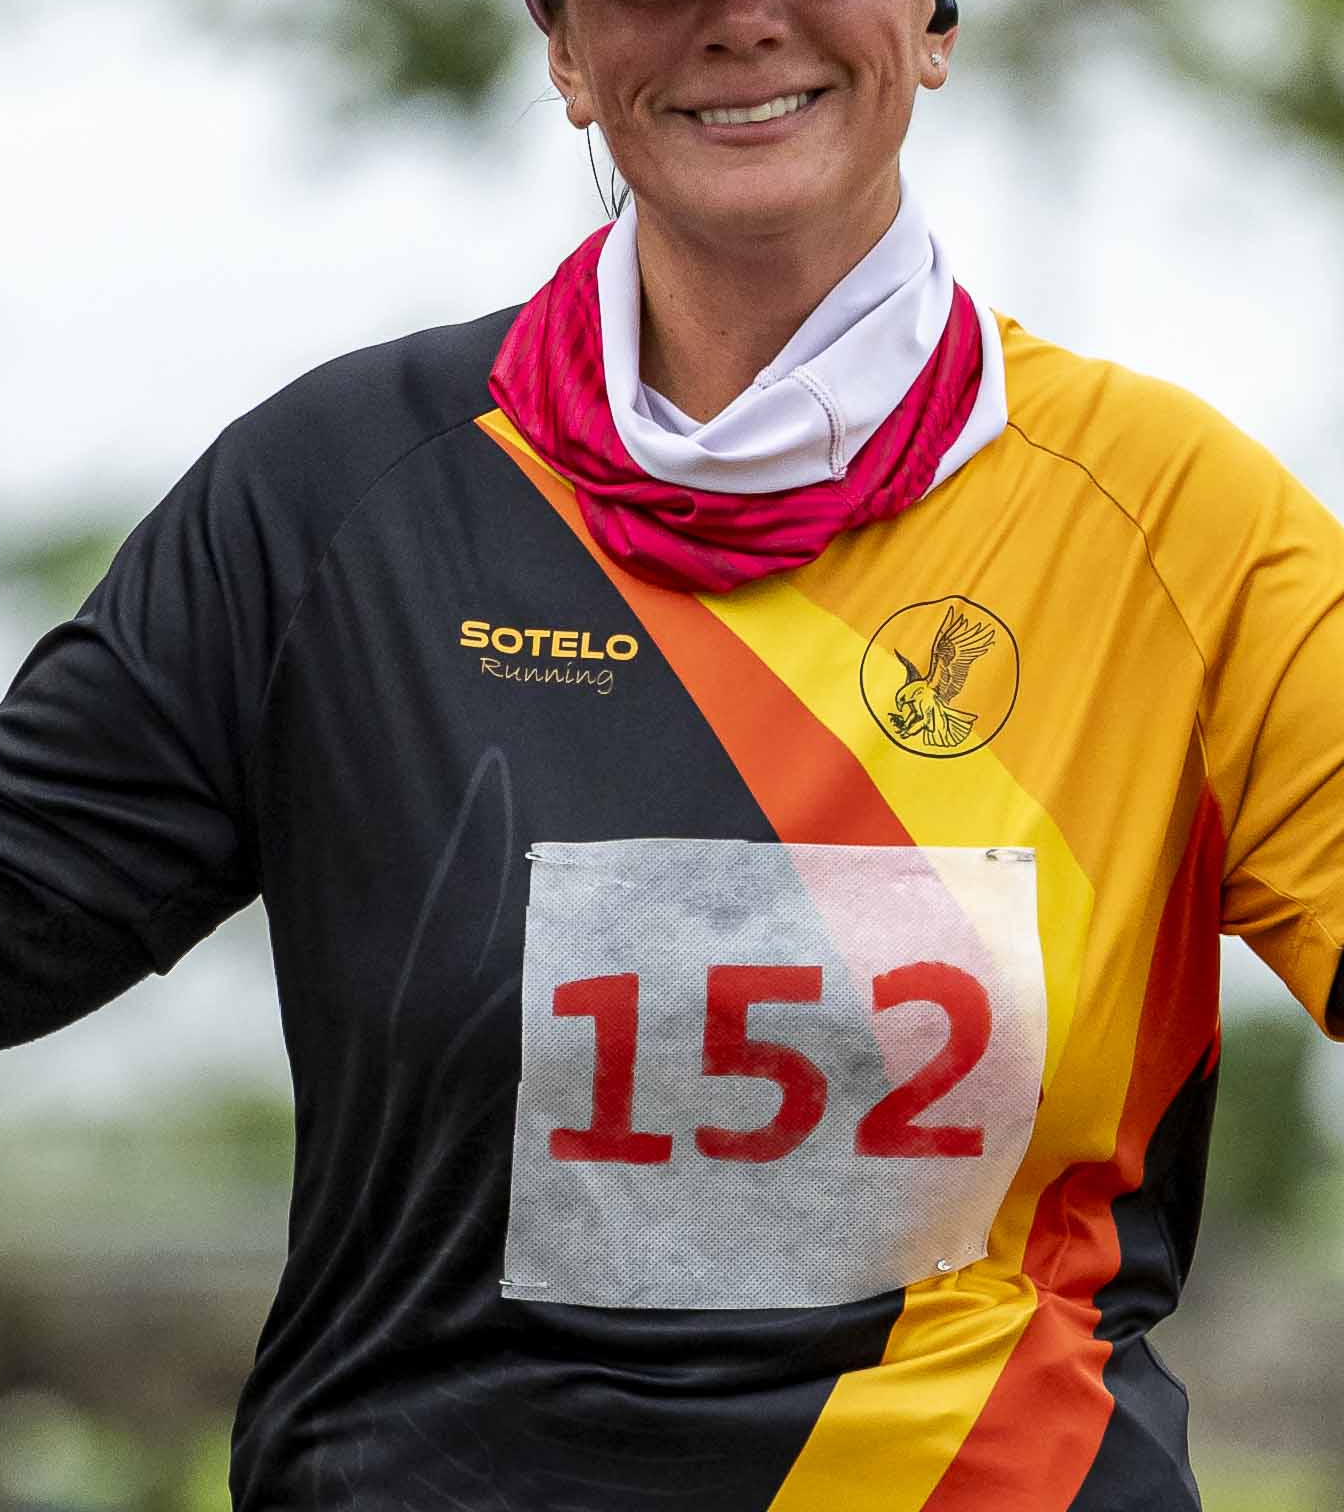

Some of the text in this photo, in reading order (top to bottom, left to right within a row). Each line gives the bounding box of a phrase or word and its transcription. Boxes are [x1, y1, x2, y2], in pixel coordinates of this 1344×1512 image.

[460, 620, 639, 661] SOTELO
[479, 657, 614, 695] Running
[549, 961, 992, 1164] 152
